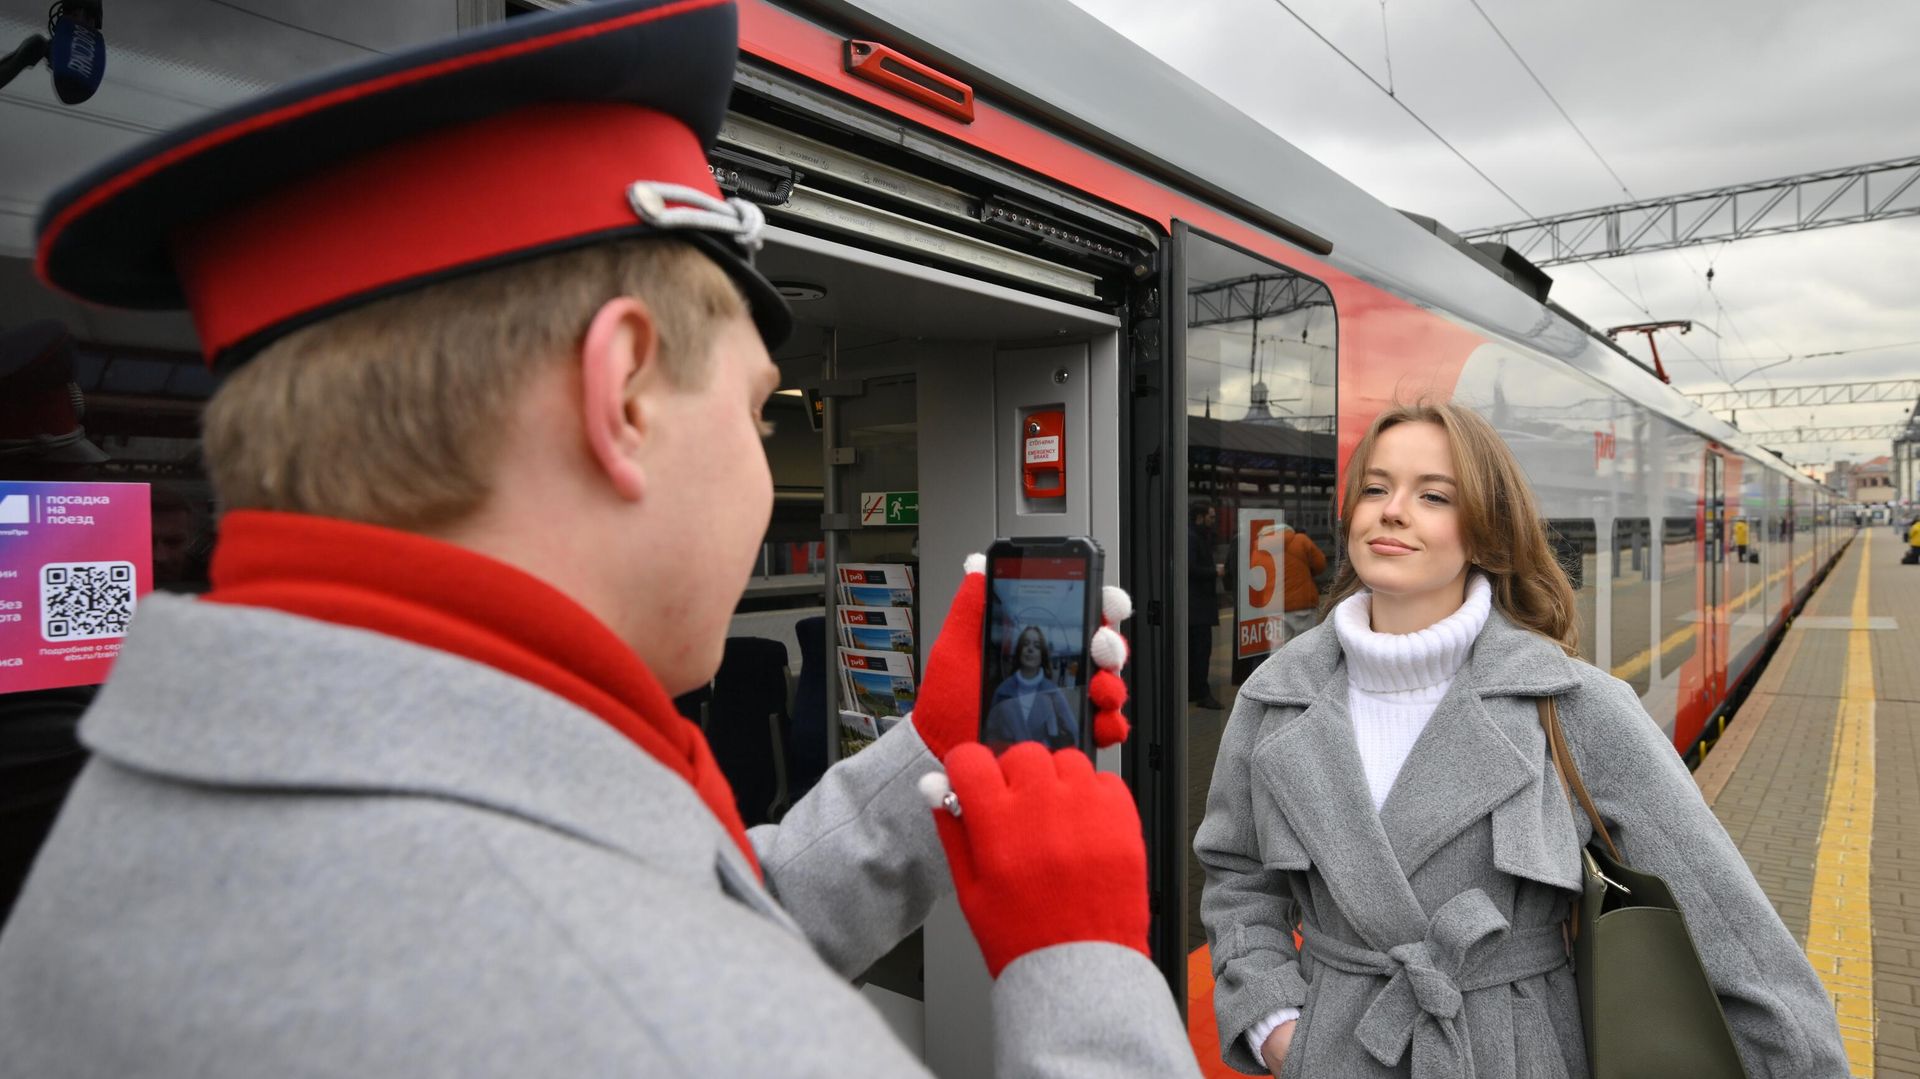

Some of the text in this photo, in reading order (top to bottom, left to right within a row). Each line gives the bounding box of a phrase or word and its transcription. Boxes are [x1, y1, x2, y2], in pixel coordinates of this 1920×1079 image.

[46, 495, 110, 506] посадка
[46, 506, 66, 514] на
[47, 515, 95, 525] поезд
[1249, 519, 1276, 608] 5
[1241, 621, 1282, 646] ВАГОН
[39, 646, 94, 656] Подробнее
